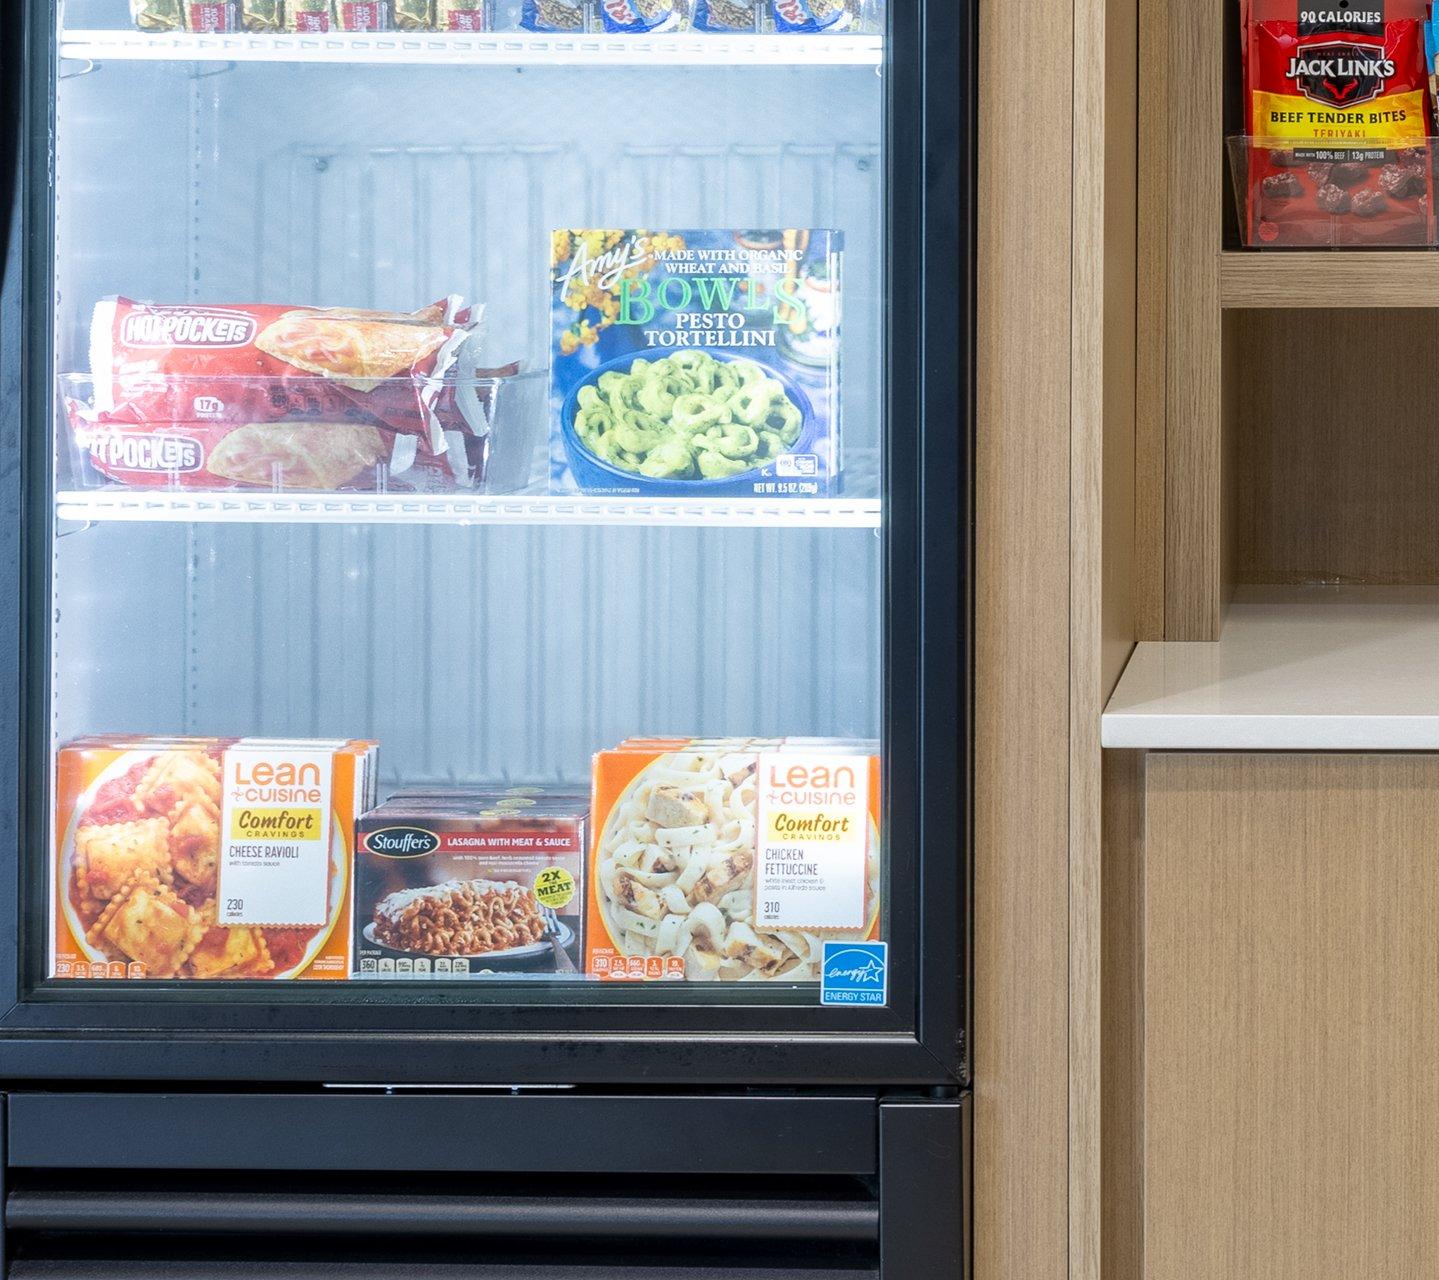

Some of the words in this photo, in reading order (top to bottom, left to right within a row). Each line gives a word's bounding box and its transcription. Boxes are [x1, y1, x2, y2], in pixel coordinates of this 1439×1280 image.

[1300, 12, 1317, 23] 90
[1319, 11, 1381, 23] CALORIES
[1286, 58, 1334, 77] JACK
[1338, 58, 1395, 77] LINK'S
[1271, 112, 1305, 123] BEEF
[1308, 112, 1365, 124] TENDER
[1369, 110, 1406, 122] BITES
[1314, 128, 1366, 138] TERIYAKI
[556, 235, 648, 302] Amy's
[615, 277, 807, 325] BOWLS
[675, 313, 745, 330] PESTO
[644, 330, 776, 347] TORTELLINI
[235, 762, 320, 786] Lean
[770, 766, 855, 788] Lean
[238, 811, 313, 830] Comfort
[775, 814, 849, 832] Comfort
[373, 834, 431, 852] Stouffer's
[448, 838, 486, 846] LASAGNA
[488, 838, 510, 846] WITH
[512, 838, 534, 846] MEAT
[536, 838, 543, 846] &
[544, 838, 571, 846] SAUCE
[229, 846, 263, 858] CHEESE
[265, 846, 299, 858] RAVIOLI
[765, 849, 804, 861] CHICKEN
[765, 864, 818, 876] FETTUCCINE
[537, 883, 572, 896] MEAT
[227, 899, 243, 910] 230
[764, 901, 780, 913] 310
[825, 992, 859, 1001] ENERGY
[860, 992, 882, 1002] STAR
